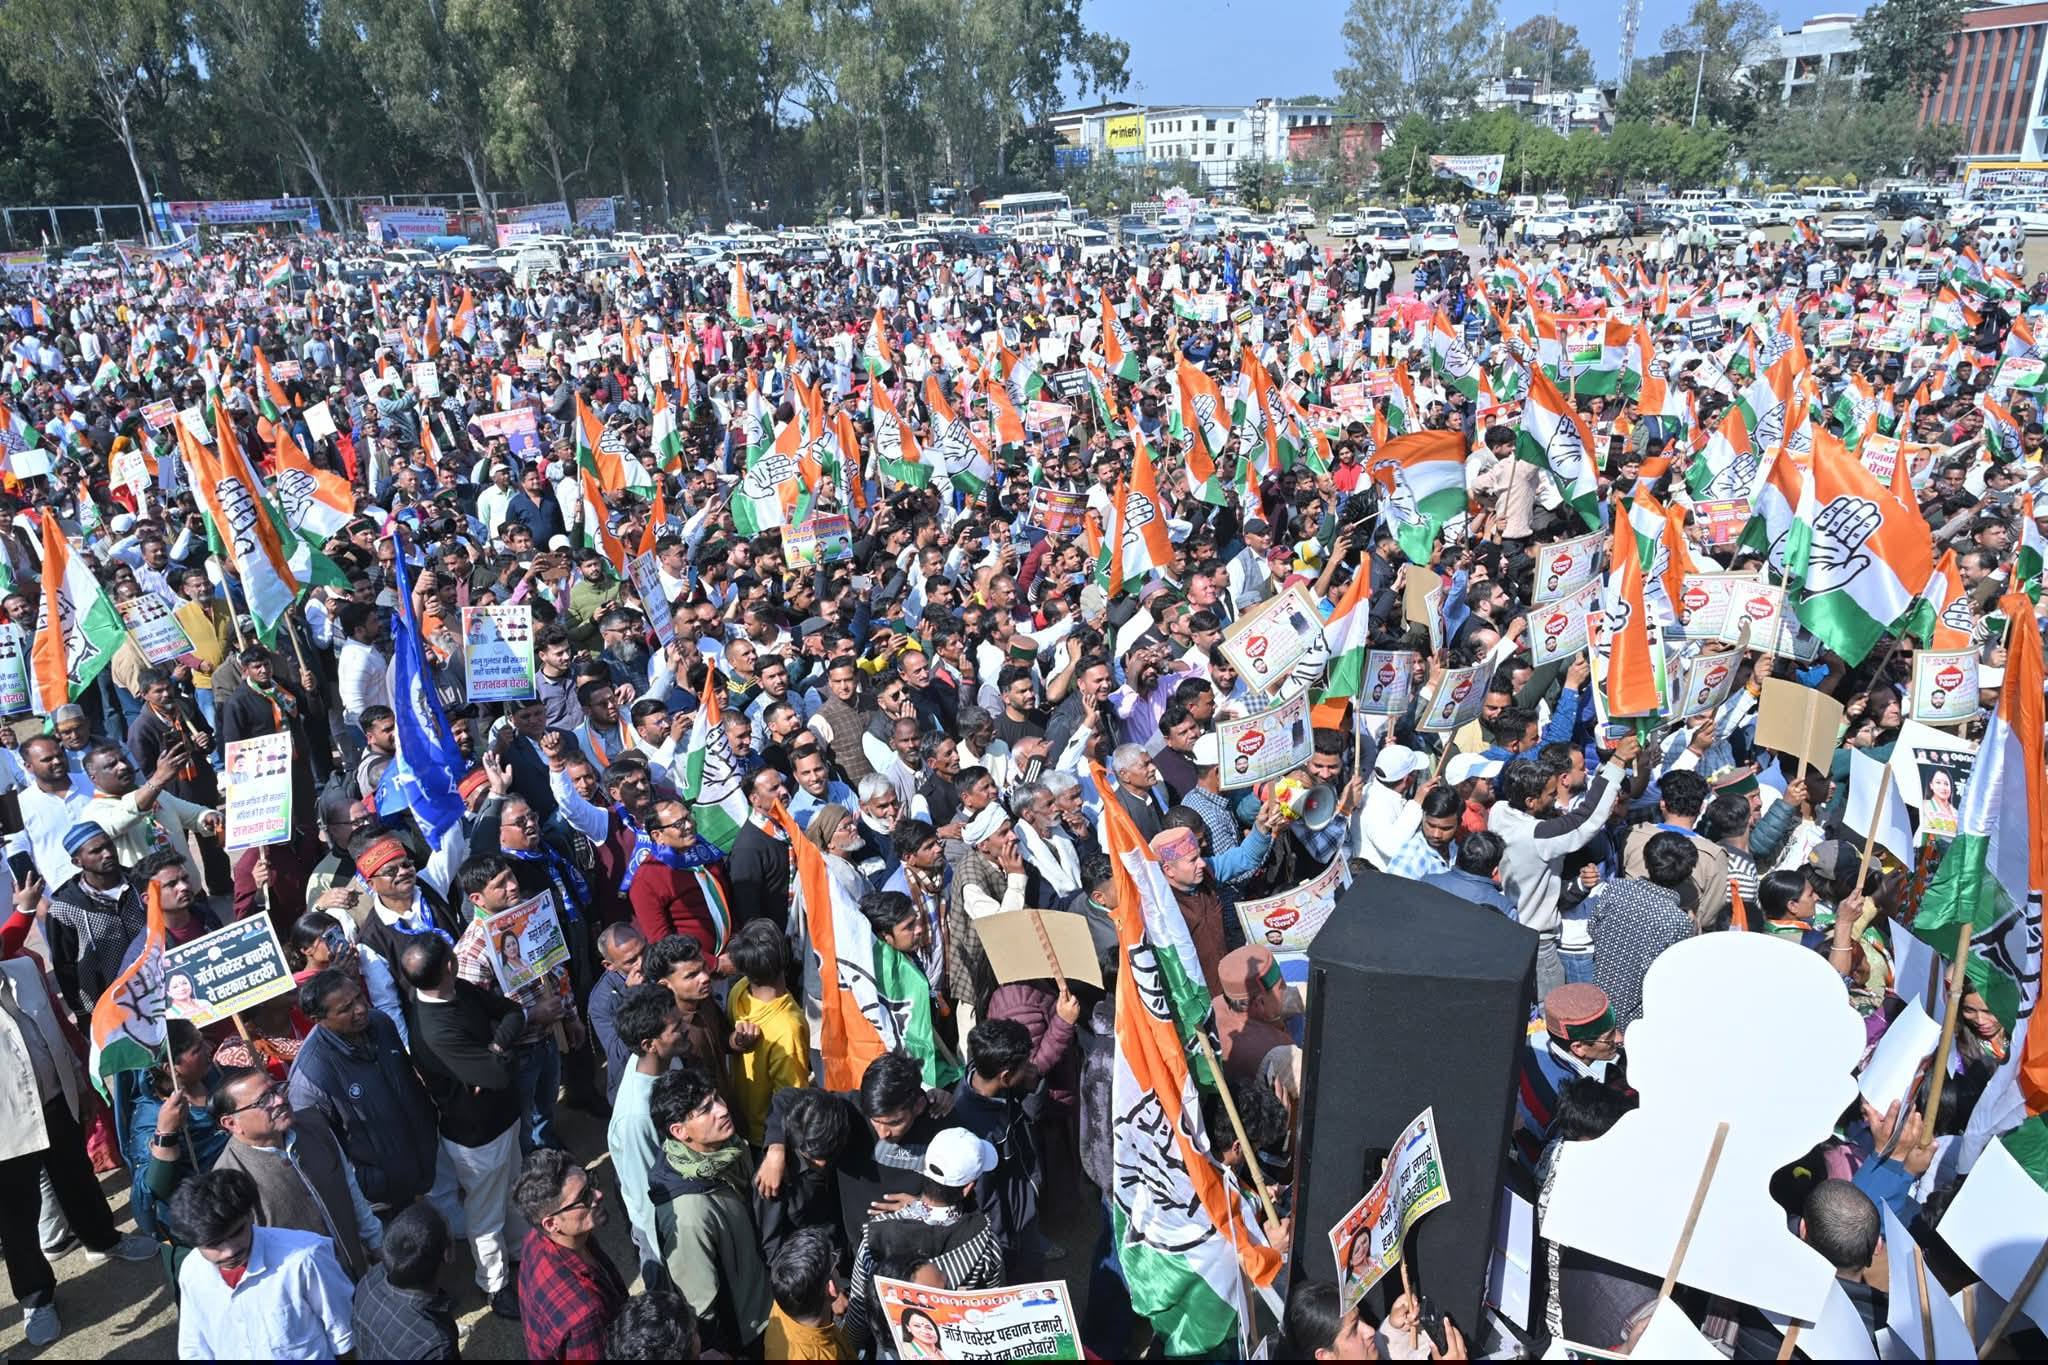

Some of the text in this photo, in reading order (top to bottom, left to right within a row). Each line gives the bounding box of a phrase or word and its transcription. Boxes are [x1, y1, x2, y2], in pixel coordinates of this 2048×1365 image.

[472, 677, 529, 690] राजभवन घेराव
[194, 967, 216, 987] जॉर्ज
[215, 957, 246, 978] एवरेस्ट
[206, 987, 217, 1002] ये
[216, 979, 249, 999] सरकार
[942, 1315, 1067, 1346] जॉर्ज एवरेस्ट पहचान हमारी,
[1011, 1337, 1058, 1358] कारोबारी
